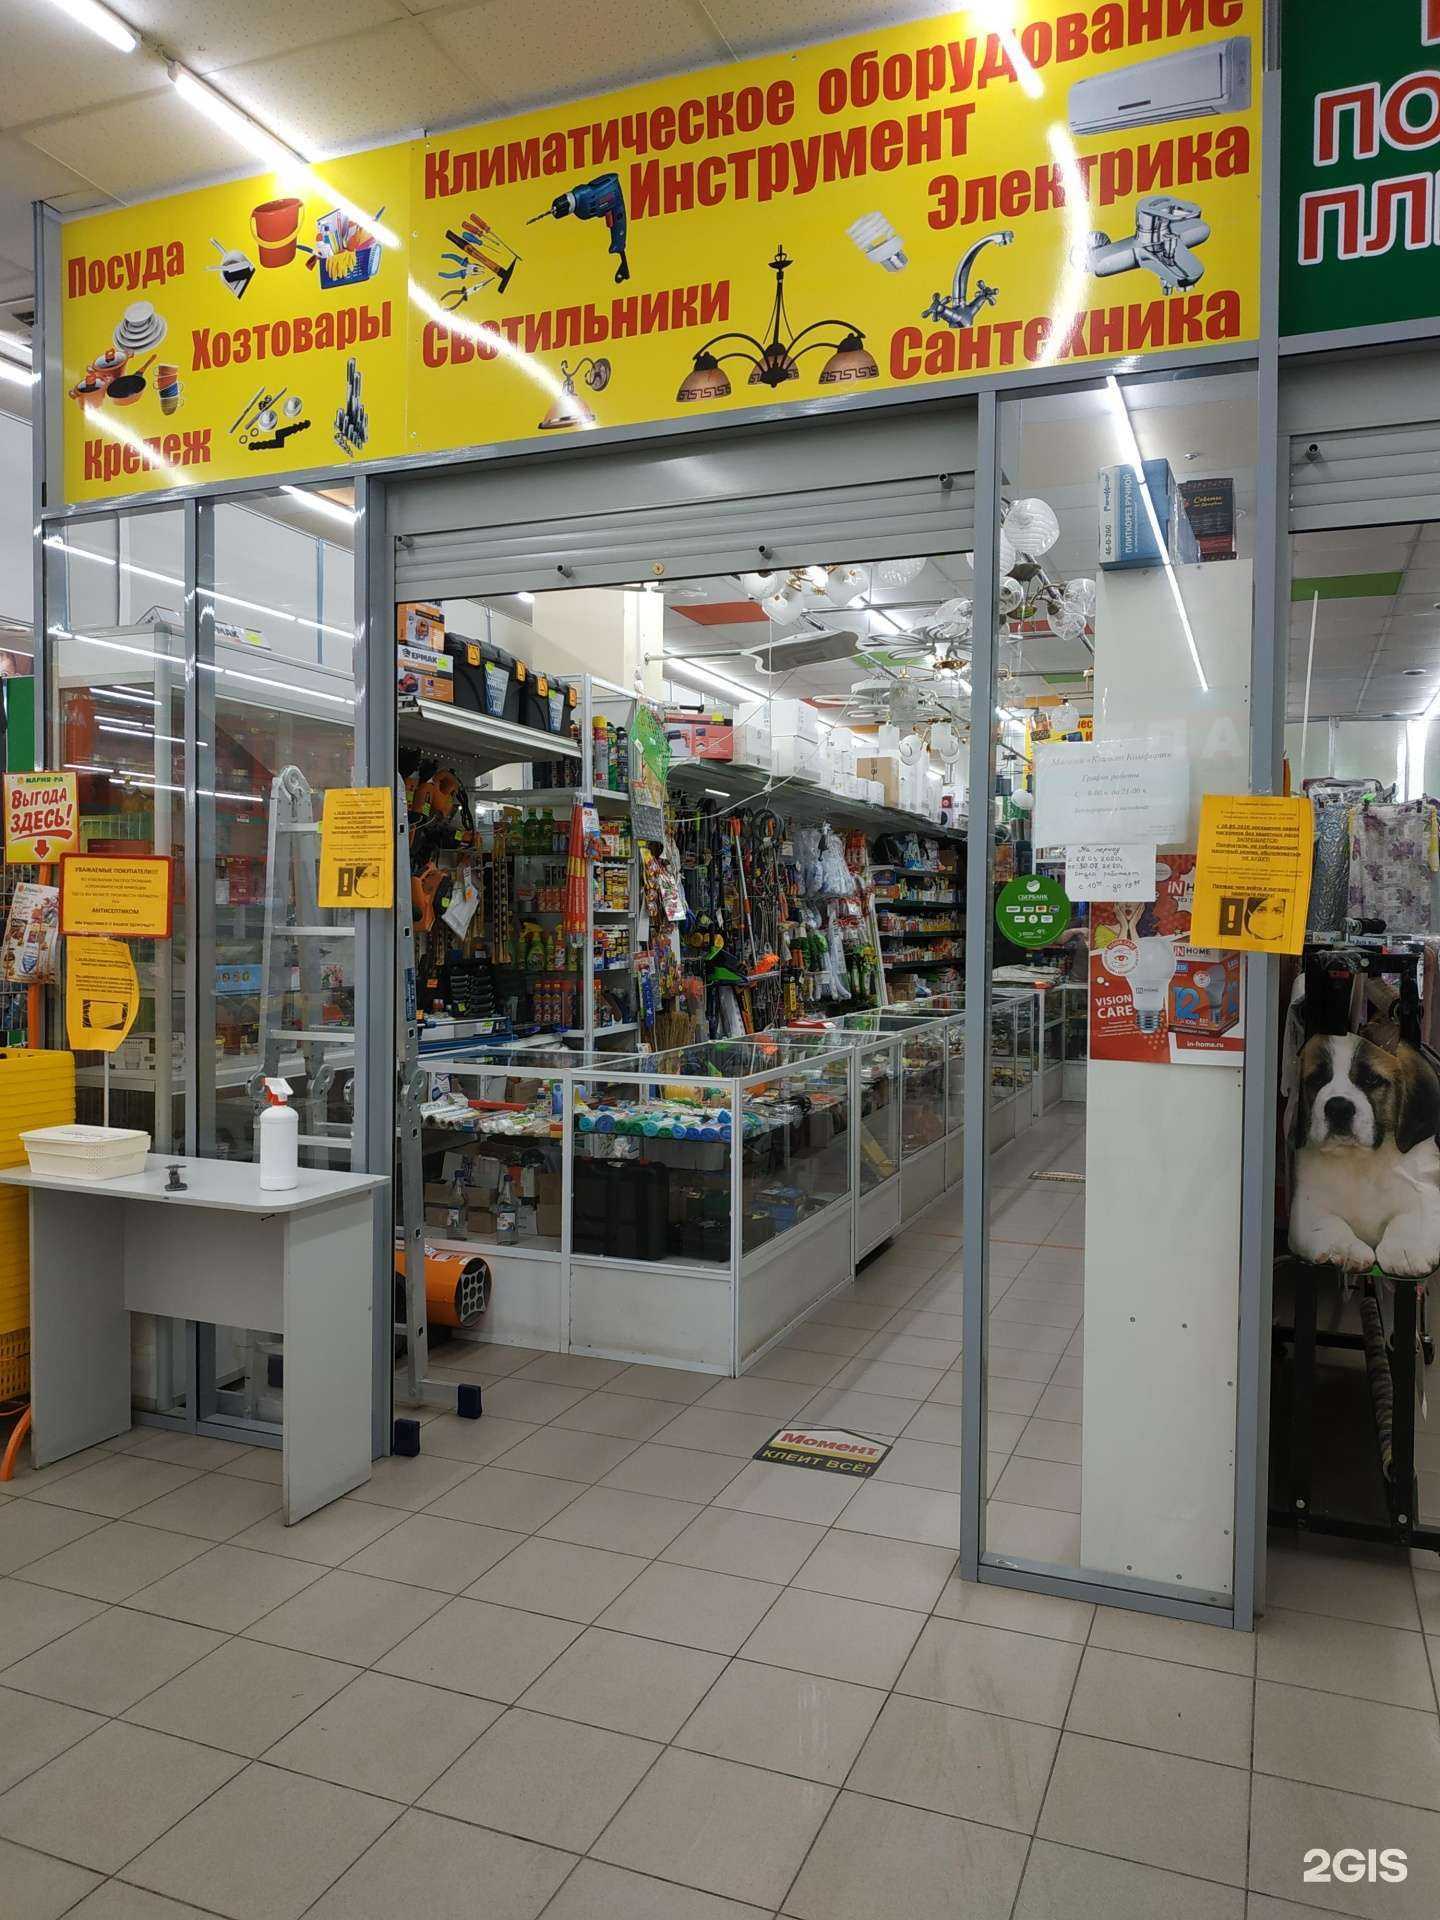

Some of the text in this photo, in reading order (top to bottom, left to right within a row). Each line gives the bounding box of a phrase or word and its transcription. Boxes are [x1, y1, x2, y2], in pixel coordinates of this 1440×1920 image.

[424, 0, 1245, 200] Климатическое оборудование
[630, 102, 976, 222] Инструмент
[927, 125, 1251, 231] Электрика
[1298, 169, 1440, 266] ПЛ
[67, 240, 185, 299] Посуда
[191, 301, 392, 371] Хозтовары
[889, 289, 1242, 380] Сантехника
[84, 428, 212, 482] Крепеж
[10, 804, 73, 834] ЗДЕСЬ!
[1095, 994, 1132, 1006] VISION
[1097, 1005, 1134, 1019] CARE
[762, 1450, 824, 1465] КЛЕИТ
[781, 1432, 880, 1456] Момент
